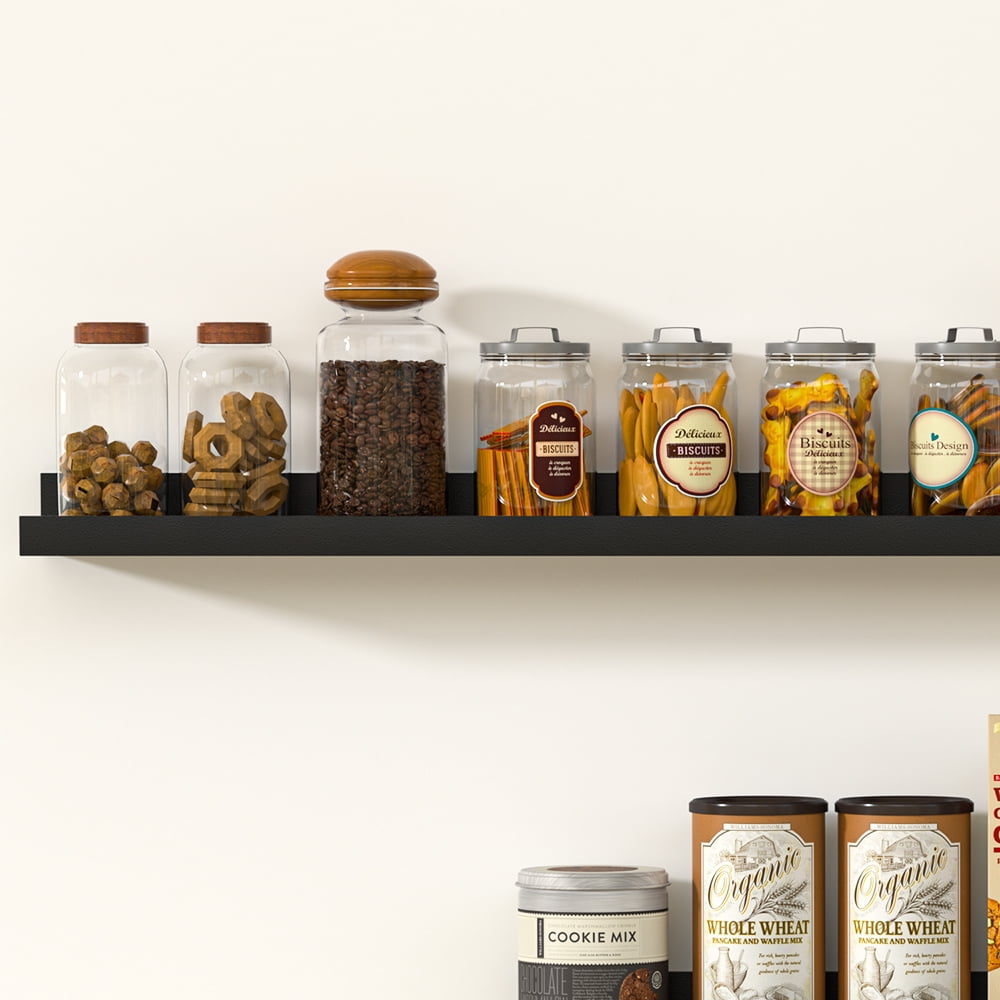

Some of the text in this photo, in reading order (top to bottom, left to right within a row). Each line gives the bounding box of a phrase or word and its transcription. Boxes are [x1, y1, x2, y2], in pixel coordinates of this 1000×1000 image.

[539, 424, 576, 432] Délicieux
[675, 429, 722, 438] Délicieux
[800, 436, 851, 448] Biscuits
[936, 441, 969, 452] Design
[543, 444, 574, 453] BISCUITS
[677, 446, 721, 455] BISCUITS
[707, 847, 801, 915] Organic
[853, 847, 947, 915] Organic
[706, 920, 810, 936] WHOLE WHEAT
[852, 920, 956, 936] WHOLE WHEAT
[548, 931, 637, 943] COOKIE MIX
[712, 937, 803, 945] PANCAKE AND WAFFLE MIX
[858, 937, 949, 945] PANCAKE AND WAFFLE MIX
